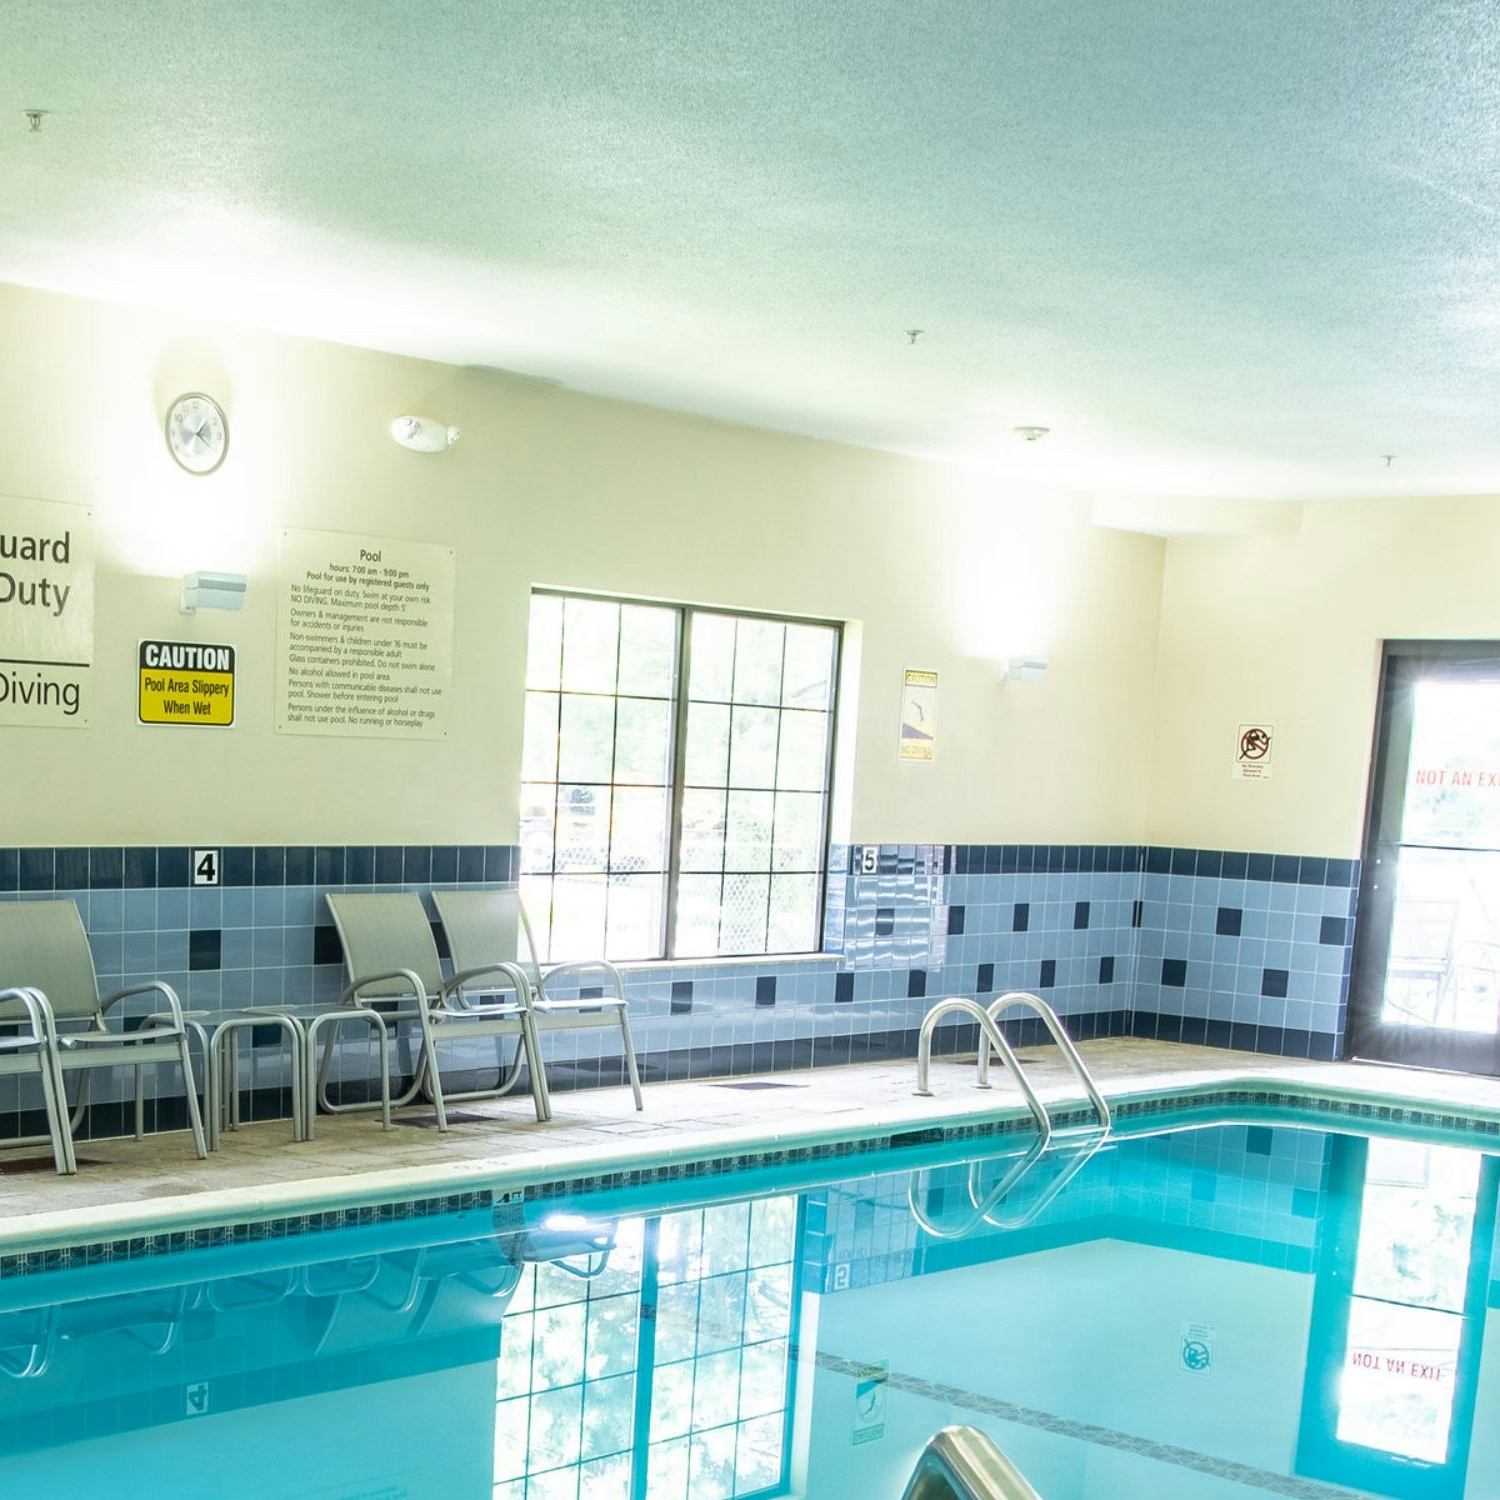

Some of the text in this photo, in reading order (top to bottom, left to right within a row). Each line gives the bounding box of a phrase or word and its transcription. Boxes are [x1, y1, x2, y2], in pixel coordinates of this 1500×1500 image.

[360, 549, 382, 562] Pool
[306, 571, 431, 592] Pool for use by registered guests only
[398, 571, 410, 579] pm
[291, 584, 302, 593] No
[303, 584, 332, 596] lifeguard
[363, 590, 380, 599] Swim
[389, 595, 403, 603] your
[290, 594, 302, 603] NO
[330, 598, 363, 608] Maximum
[364, 601, 380, 610] pool
[380, 603, 400, 612] depth
[290, 608, 317, 618] Owners
[318, 610, 324, 618] &
[325, 612, 369, 622] management
[394, 618, 429, 627] responsible
[290, 618, 300, 627] for
[301, 620, 332, 629] accidents
[342, 624, 365, 632] injuries
[289, 644, 332, 653] accompanied
[333, 646, 342, 655] by
[349, 648, 385, 657] responsible
[340, 636, 345, 644] &
[347, 636, 372, 646] children
[373, 639, 392, 648] under
[403, 641, 418, 649] must
[419, 642, 428, 650] be
[145, 644, 230, 671] CAUTION
[289, 653, 306, 663] Glass
[307, 656, 341, 665] containers
[377, 660, 387, 668] Do
[388, 661, 400, 669] not
[419, 663, 436, 671] alone
[289, 667, 375, 680] No alcohol allowed in pool
[145, 677, 230, 698] Pool Area Slippery
[289, 679, 314, 688] Persons
[315, 681, 331, 689] with
[332, 682, 377, 692] communicable
[378, 684, 403, 693] diseases
[404, 686, 418, 694] shall
[419, 687, 431, 695] not
[307, 690, 383, 704] Shower before entering
[164, 700, 212, 716] When Wet
[288, 702, 313, 712] Persons
[314, 705, 334, 713] under
[335, 705, 347, 713] the
[348, 705, 377, 715] influence
[378, 707, 386, 715] of
[386, 708, 409, 717] alcohol
[418, 710, 436, 719] drugs
[287, 713, 303, 722] shall
[304, 715, 316, 723] not
[348, 716, 359, 724] No
[359, 718, 384, 728] running
[393, 717, 423, 729] horseplay
[1415, 769, 1447, 786] NOT
[1451, 770, 1475, 786] AN
[196, 853, 216, 882] 4
[864, 850, 875, 871] 5
